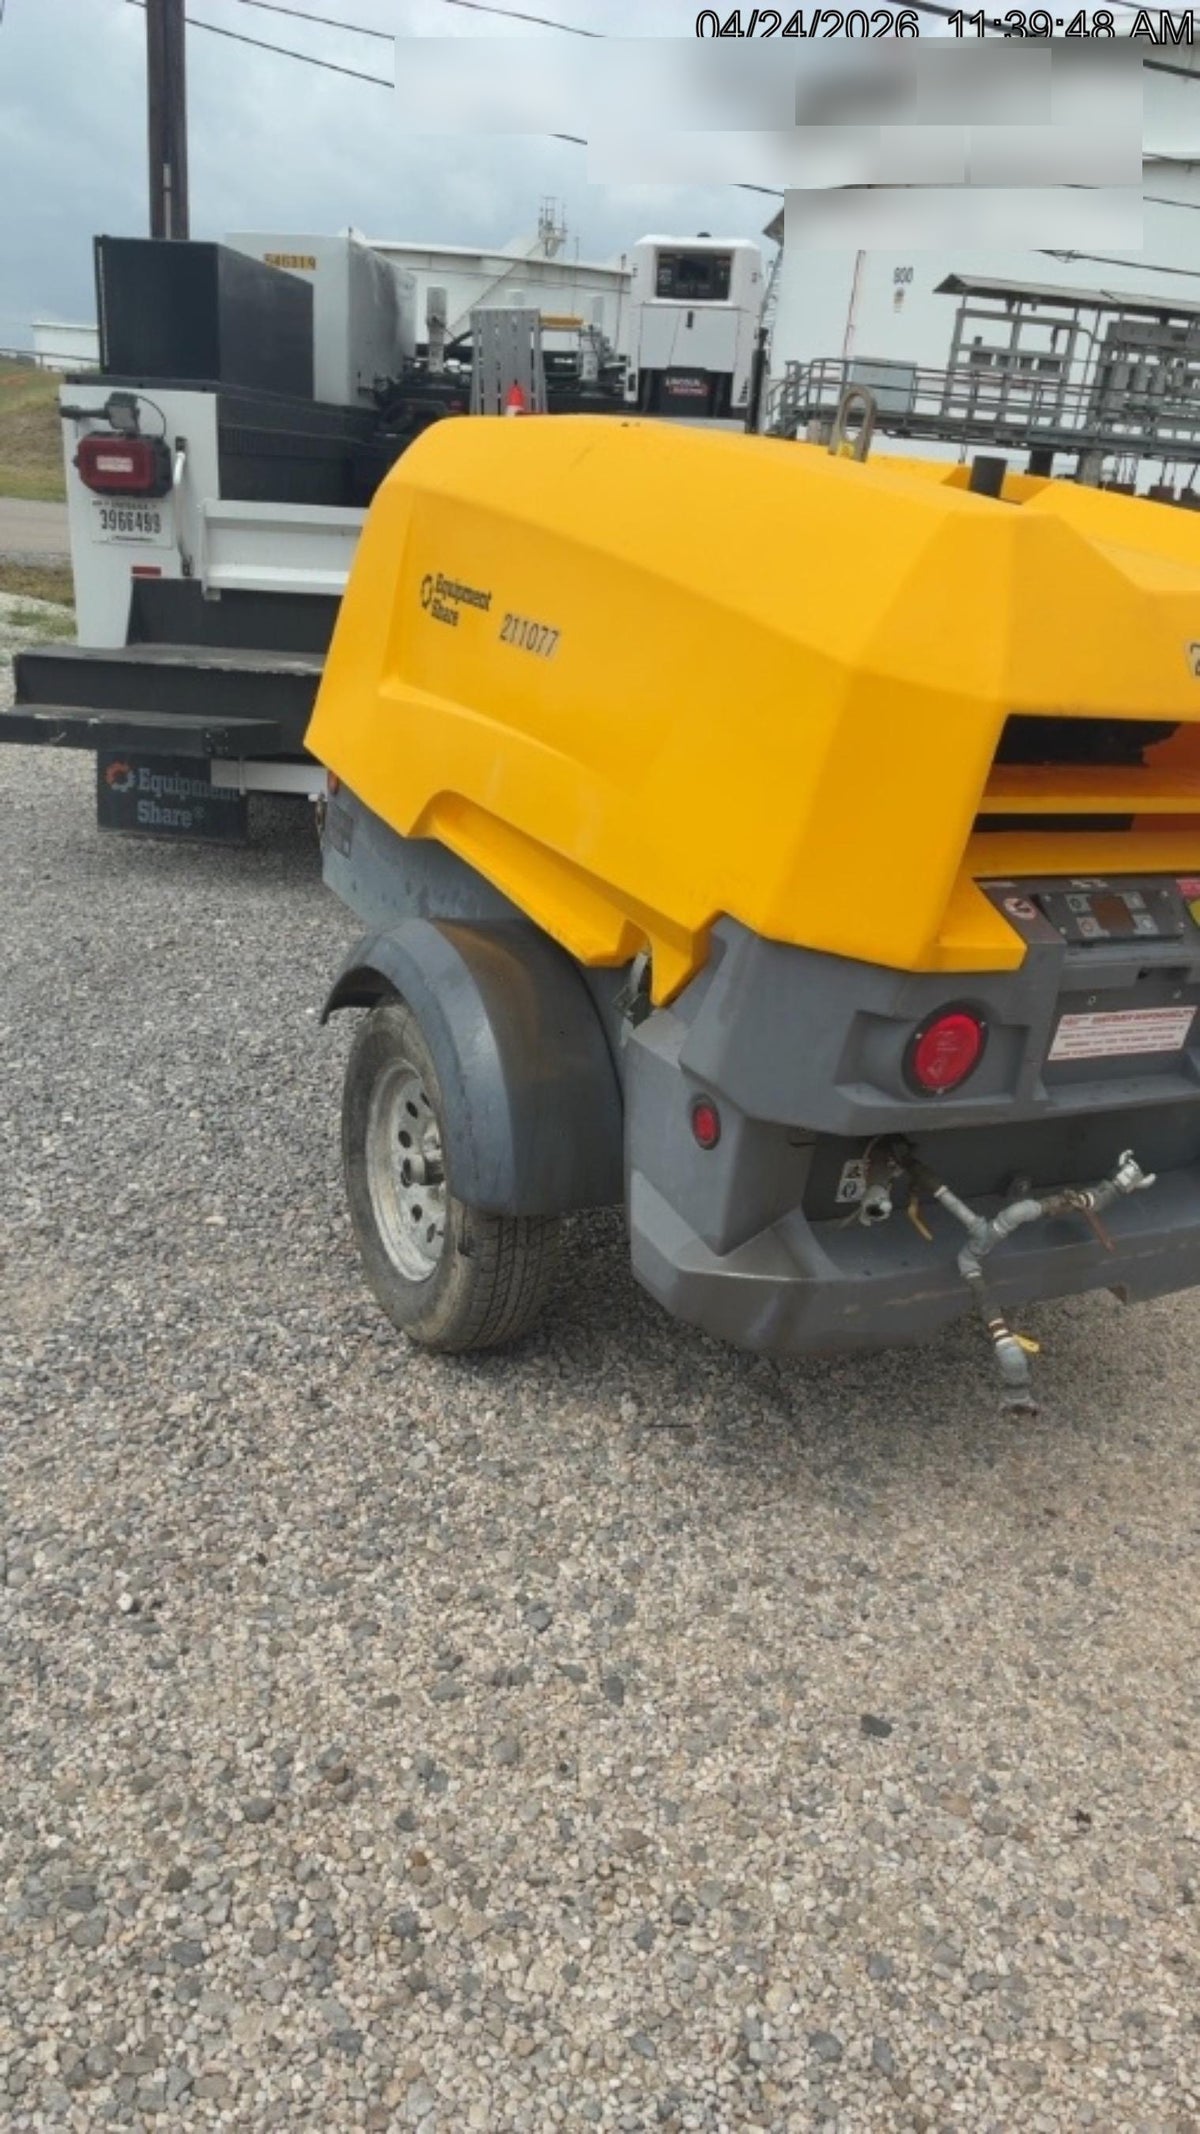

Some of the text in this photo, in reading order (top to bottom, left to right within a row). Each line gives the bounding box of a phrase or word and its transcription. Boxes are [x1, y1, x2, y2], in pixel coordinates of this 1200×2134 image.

[431, 598, 459, 626] Share
[435, 572, 492, 612] Equipment
[499, 613, 560, 657] 211077
